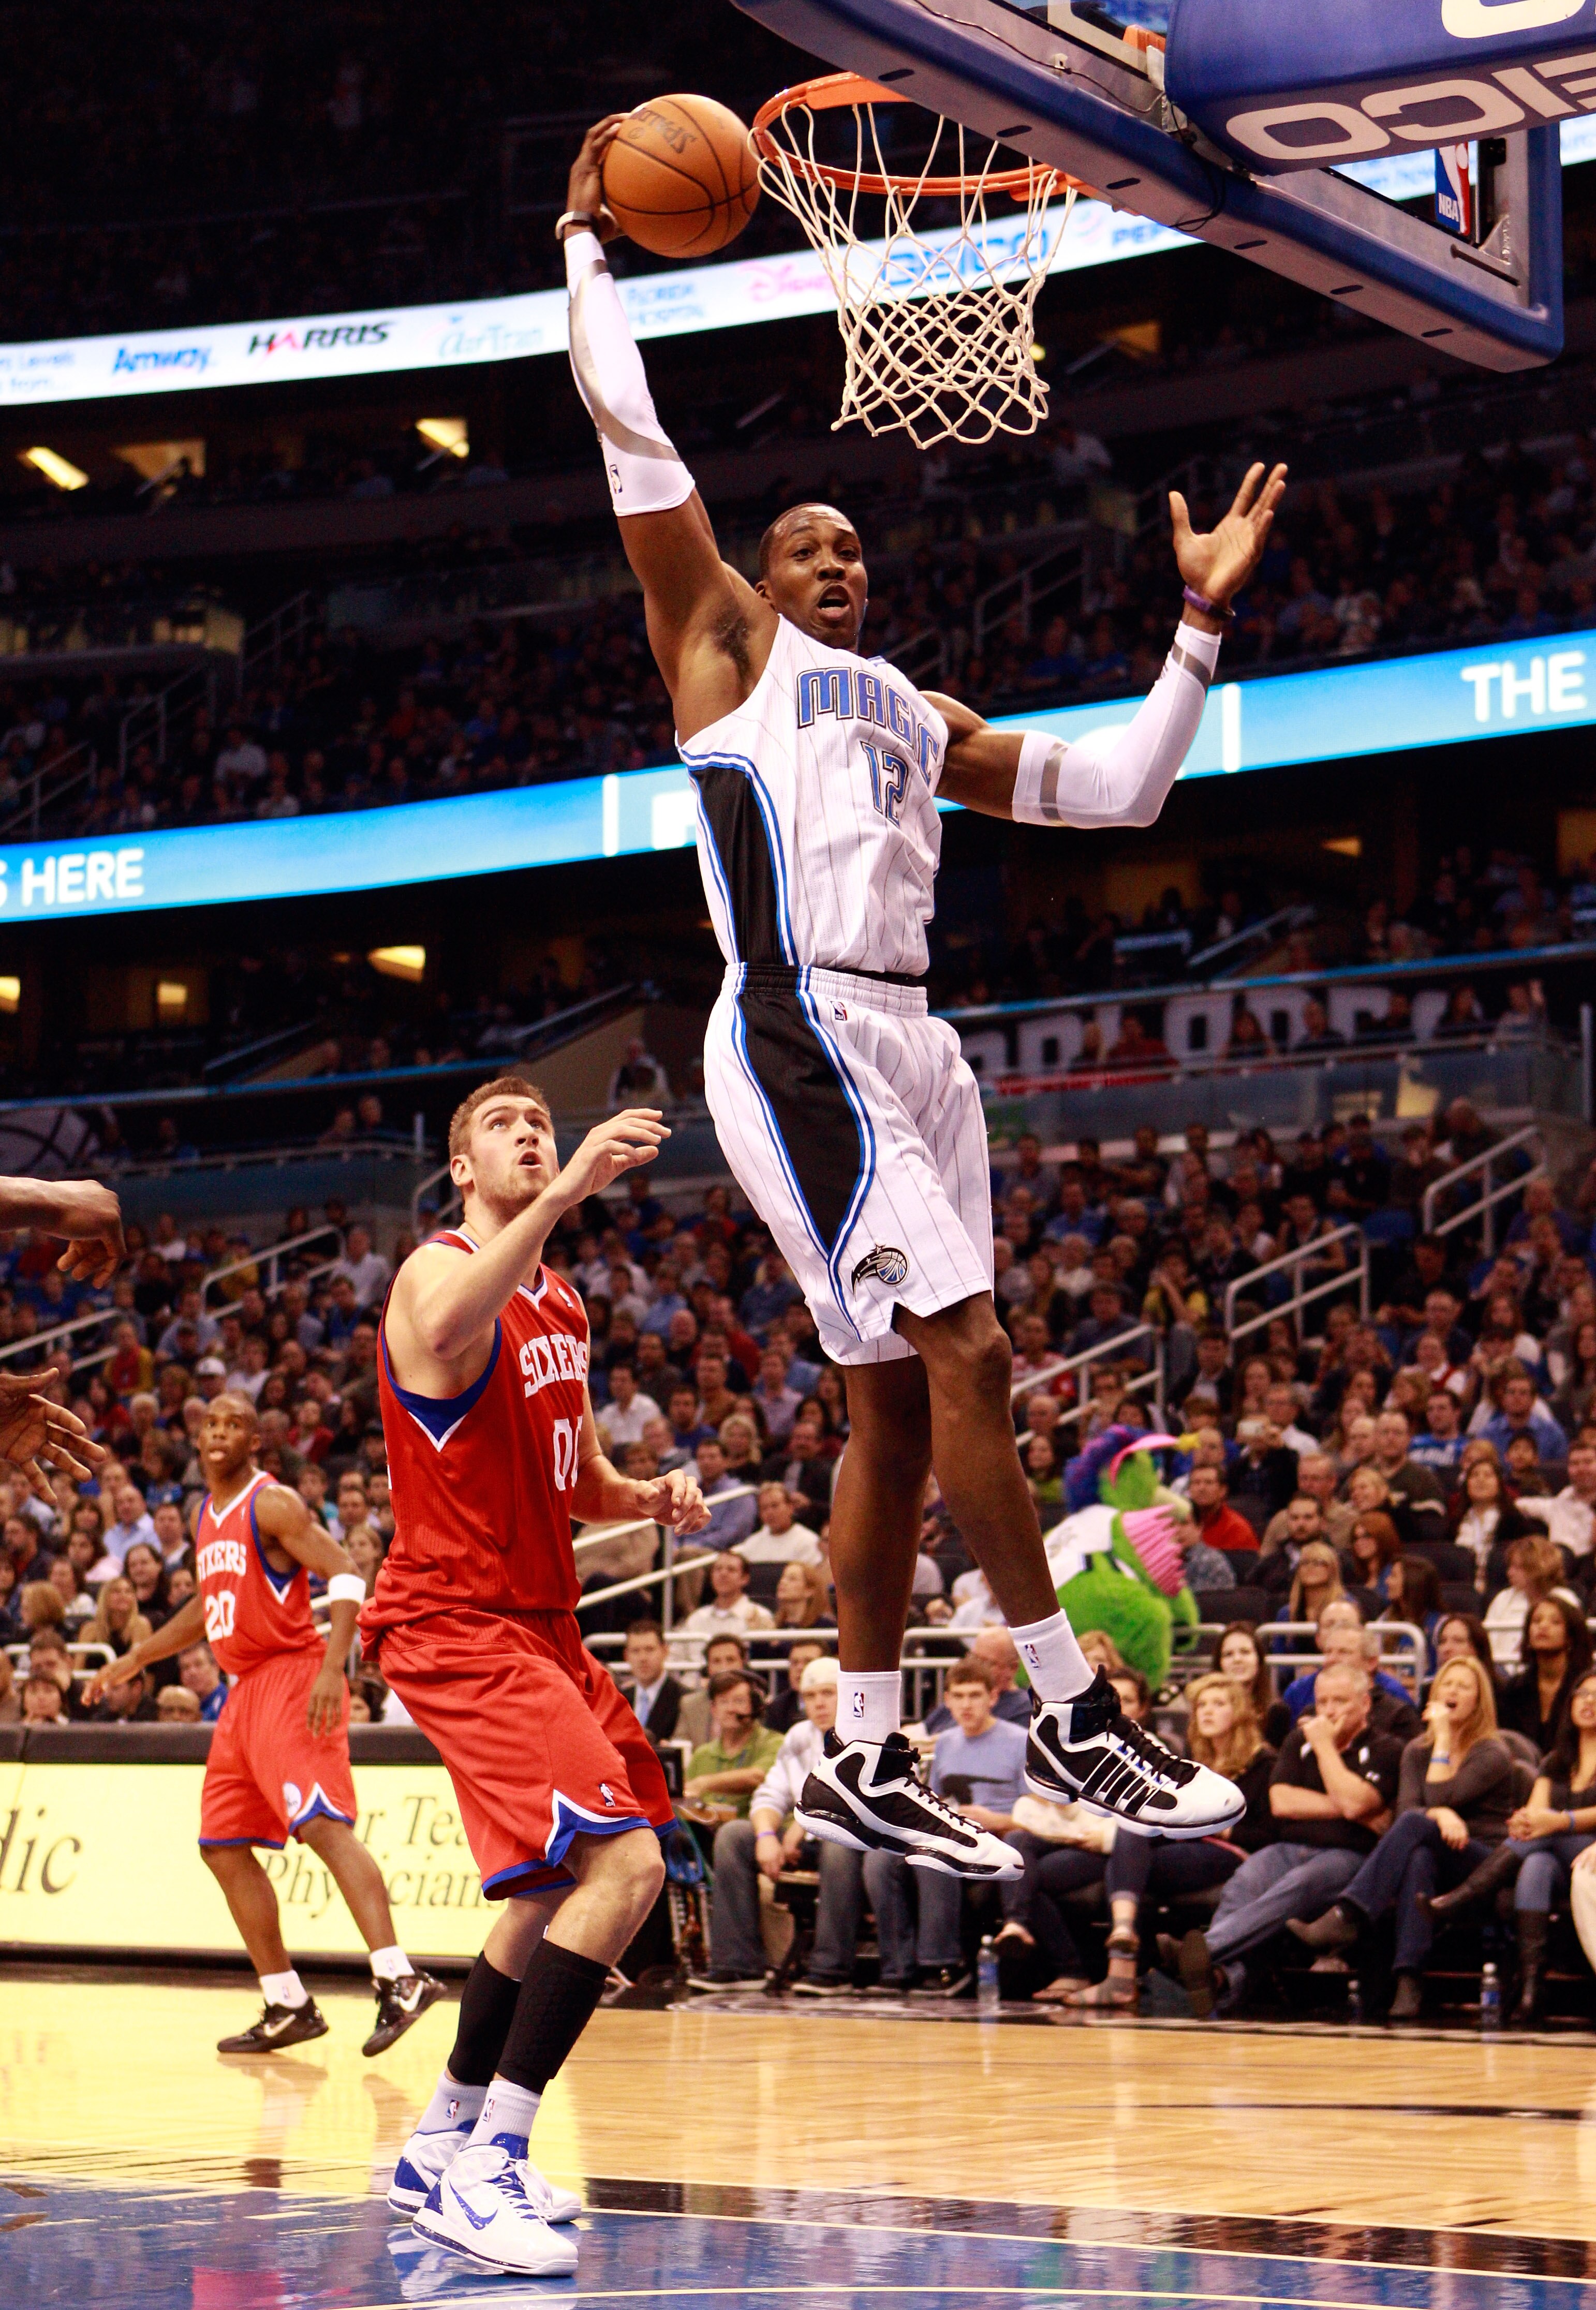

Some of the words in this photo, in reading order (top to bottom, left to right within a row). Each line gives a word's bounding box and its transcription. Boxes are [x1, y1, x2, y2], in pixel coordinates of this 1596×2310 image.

[1438, 192, 1459, 223] NBA
[880, 230, 1048, 286] GEICO
[110, 346, 212, 376] Amway
[247, 322, 392, 357] HARRIS
[1460, 651, 1587, 722] THE
[860, 741, 909, 828] 12
[21, 848, 145, 907] HERE
[519, 1333, 588, 1398] SIXERS
[196, 1540, 247, 1583] IXERS
[204, 1589, 236, 1642] 20
[405, 1795, 469, 1847] Te
